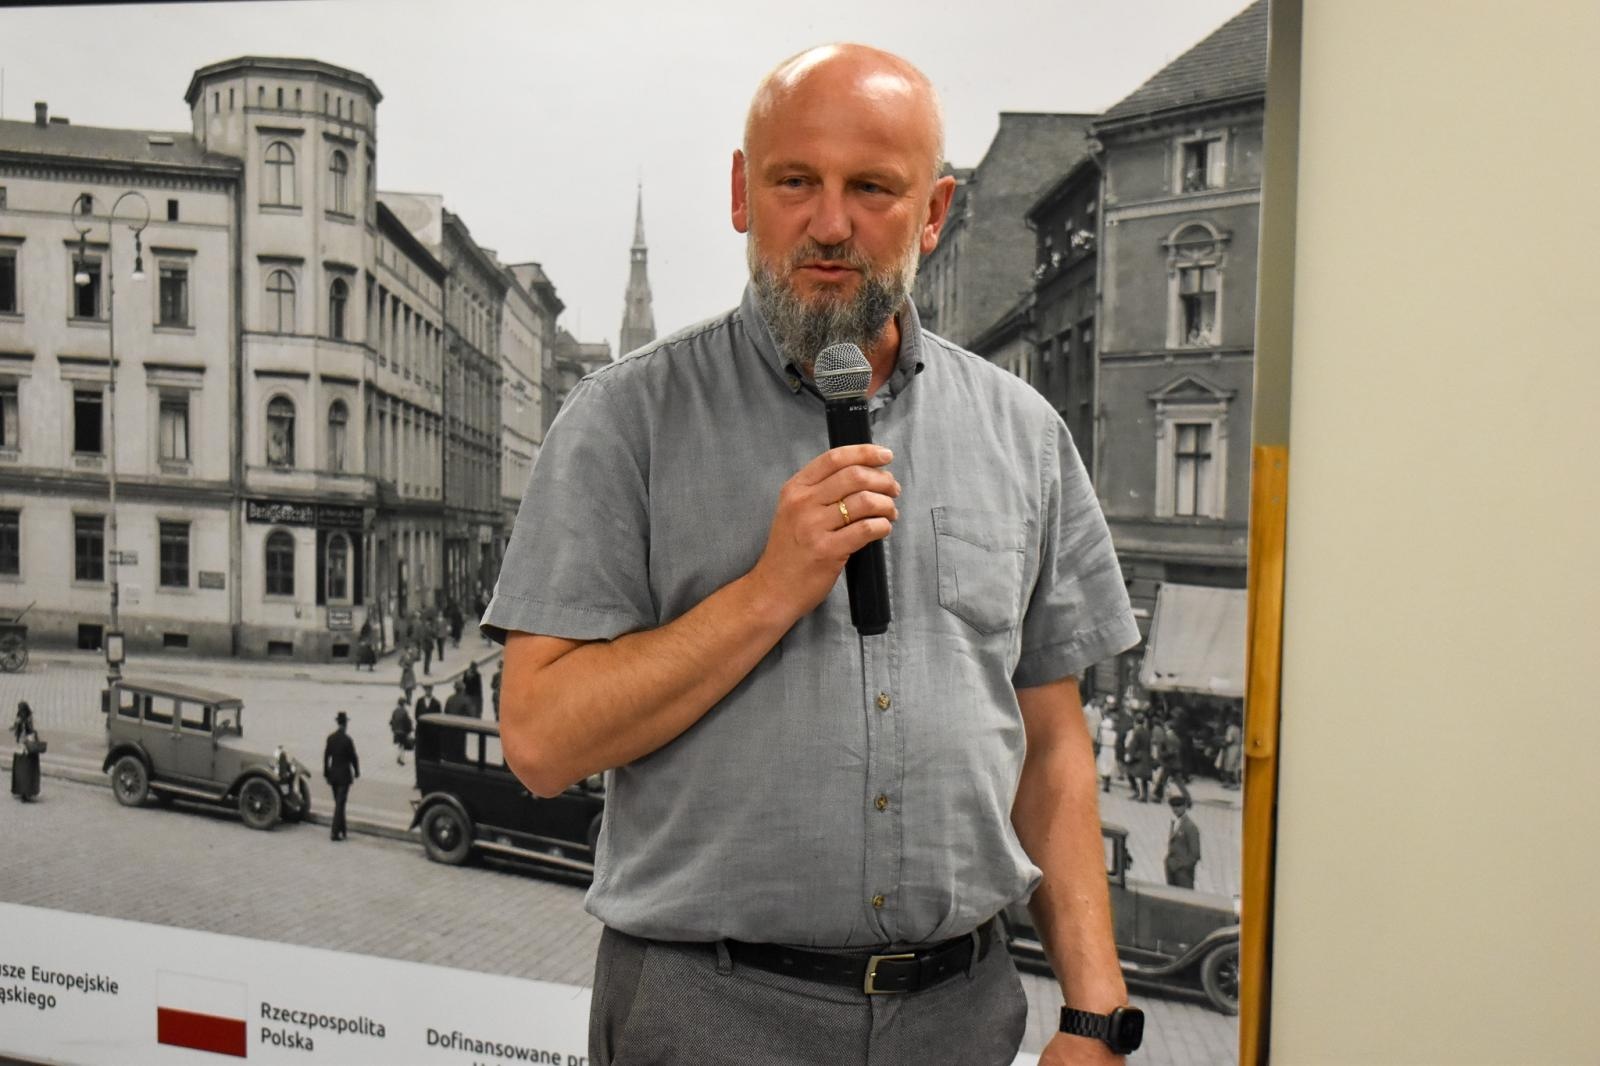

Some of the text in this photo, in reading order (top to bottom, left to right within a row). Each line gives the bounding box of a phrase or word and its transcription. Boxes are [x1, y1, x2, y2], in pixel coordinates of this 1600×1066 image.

[0, 964, 119, 994] sze Europejskie
[261, 1002, 386, 1038] Rzeczpospolita
[261, 1027, 314, 1052] Polska
[427, 1028, 588, 1066] Dofinansowane pr
